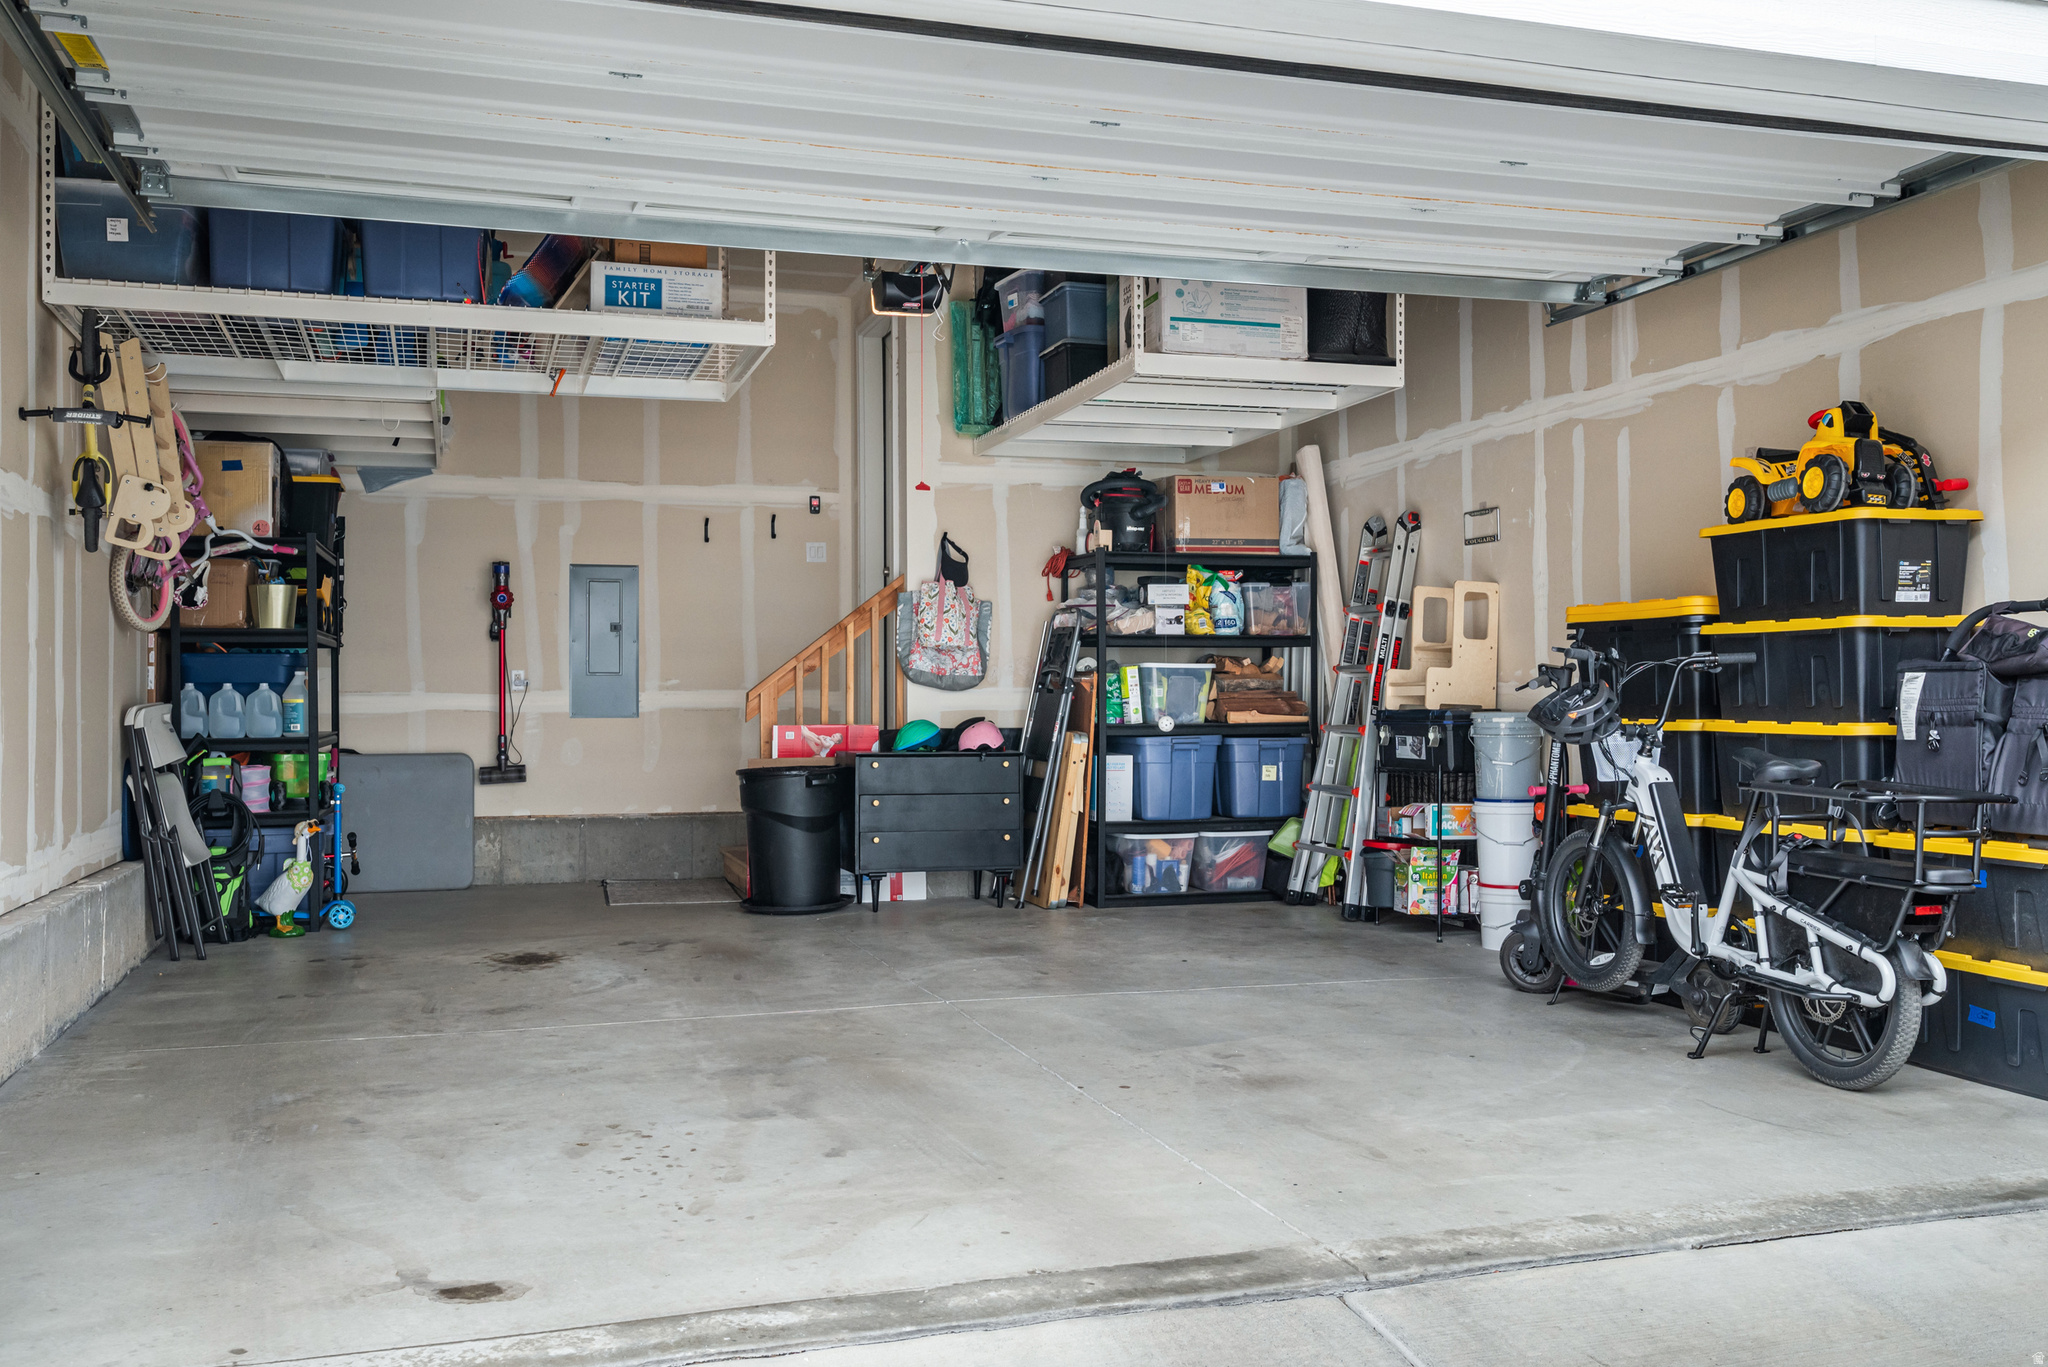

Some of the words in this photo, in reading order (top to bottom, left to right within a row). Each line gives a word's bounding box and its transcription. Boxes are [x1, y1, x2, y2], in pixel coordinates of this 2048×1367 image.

[673, 270, 714, 278] STORAGE
[611, 280, 656, 291] STARTER
[618, 290, 651, 307] KIT
[65, 411, 103, 420] STRIDER
[1194, 484, 1245, 495] MEUM
[1379, 637, 1388, 659] MULTI
[1374, 664, 1384, 683] Giant
[1372, 682, 1381, 701] Little
[1549, 747, 1561, 780] PHANTOM
[1422, 871, 1448, 880] Italin
[1427, 879, 1438, 887] Ice
[1800, 918, 1821, 931] CARRIER
